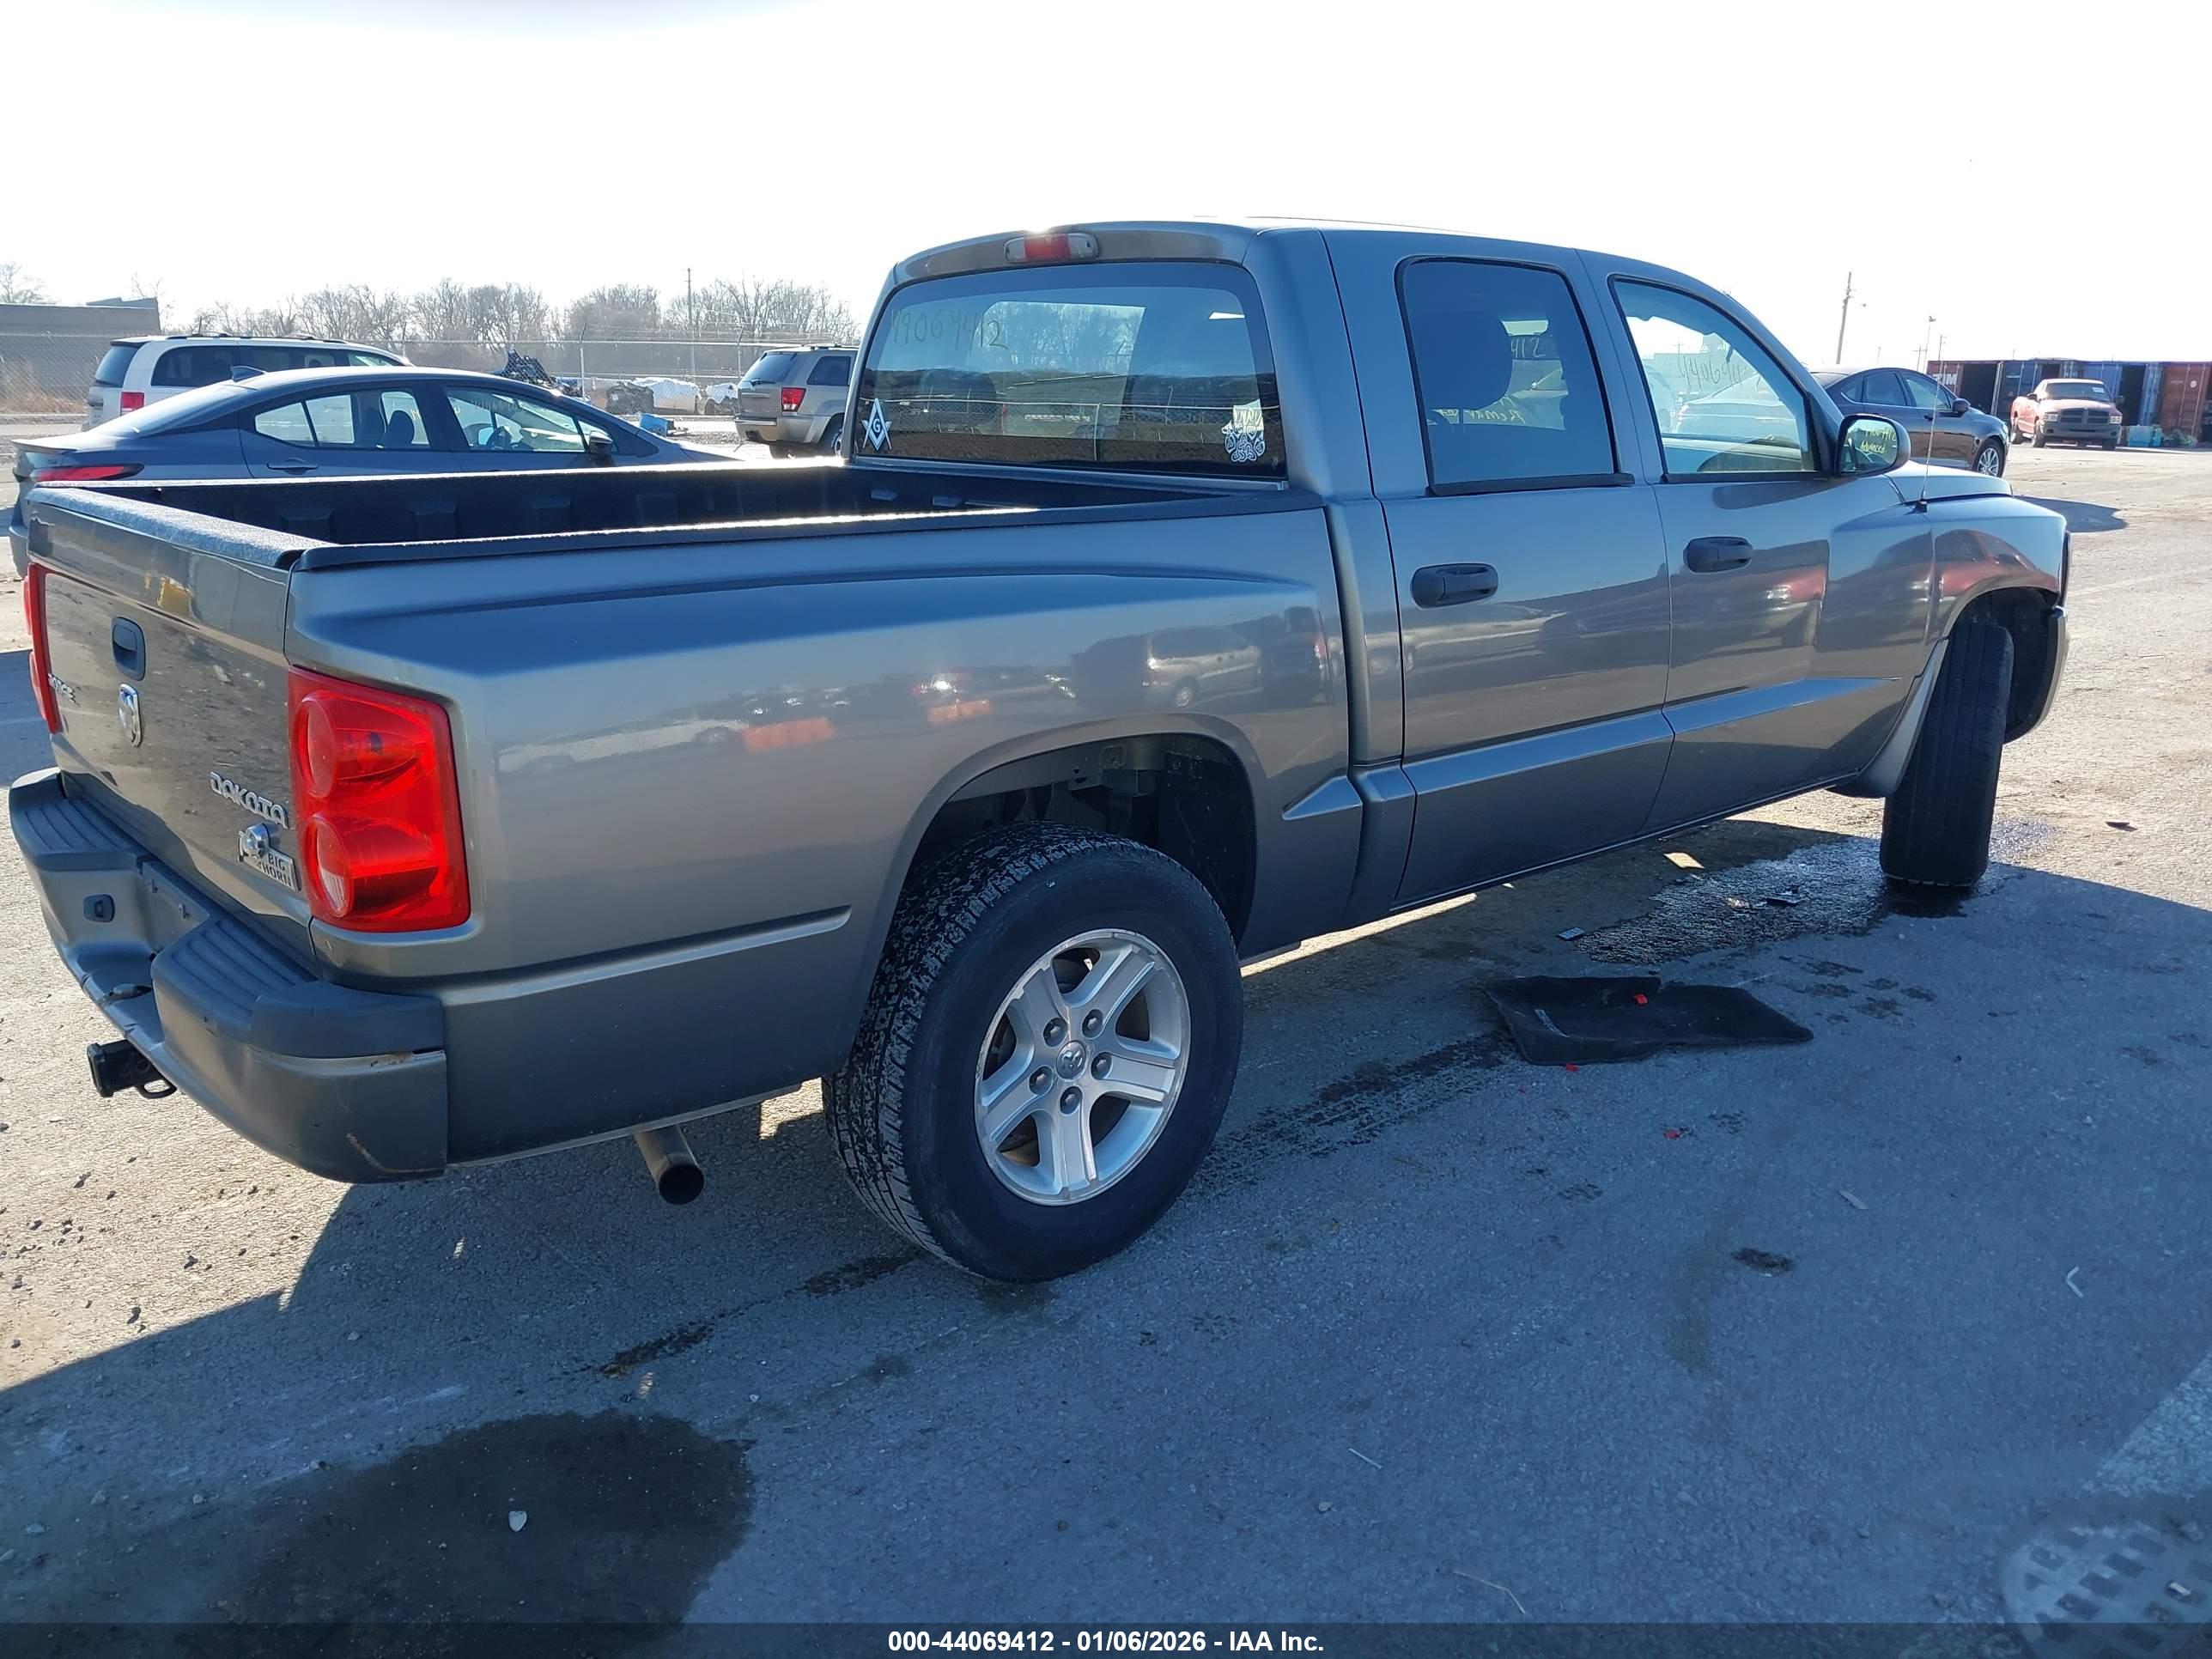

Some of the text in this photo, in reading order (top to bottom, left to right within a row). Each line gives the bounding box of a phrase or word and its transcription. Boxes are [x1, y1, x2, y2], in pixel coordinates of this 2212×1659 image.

[210, 771, 289, 830] DAKOTA
[268, 852, 286, 871] BIG
[263, 863, 292, 887] HORN
